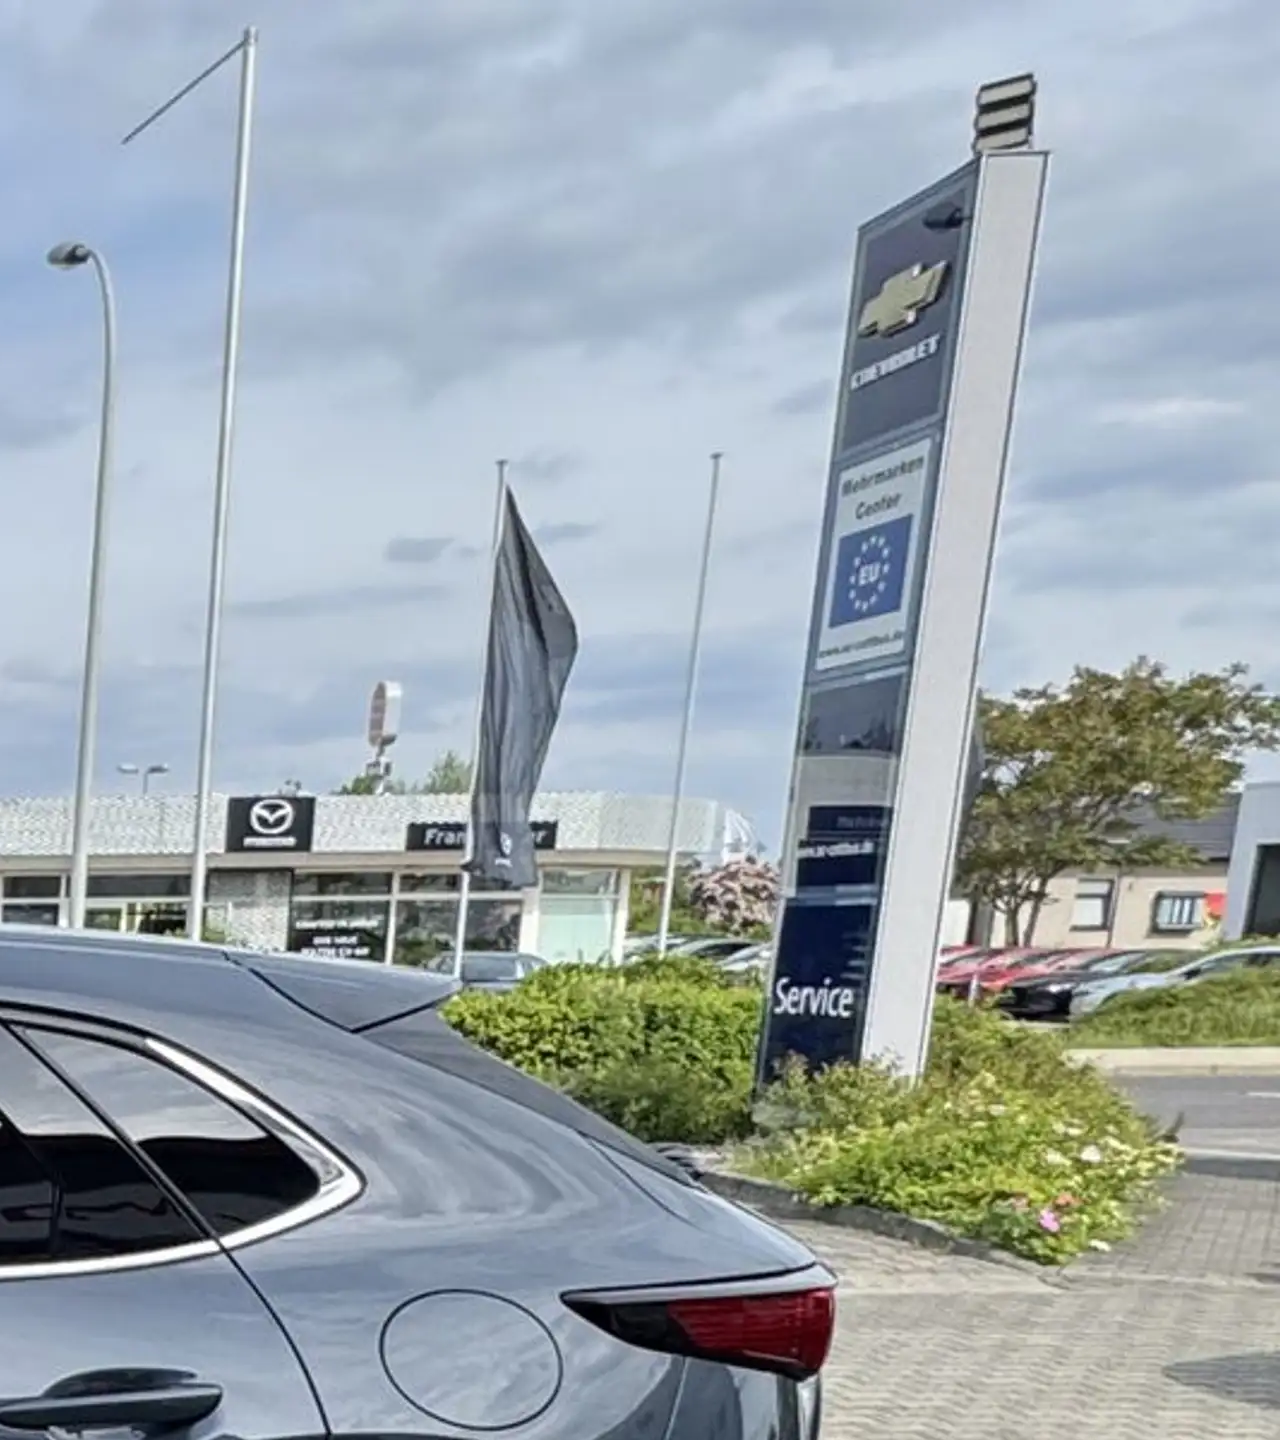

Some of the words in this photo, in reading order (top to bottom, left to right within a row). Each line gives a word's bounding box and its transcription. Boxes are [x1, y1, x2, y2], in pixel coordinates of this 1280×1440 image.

[855, 493, 903, 520] Center
[858, 562, 881, 586] EU
[773, 976, 855, 1018] Service
